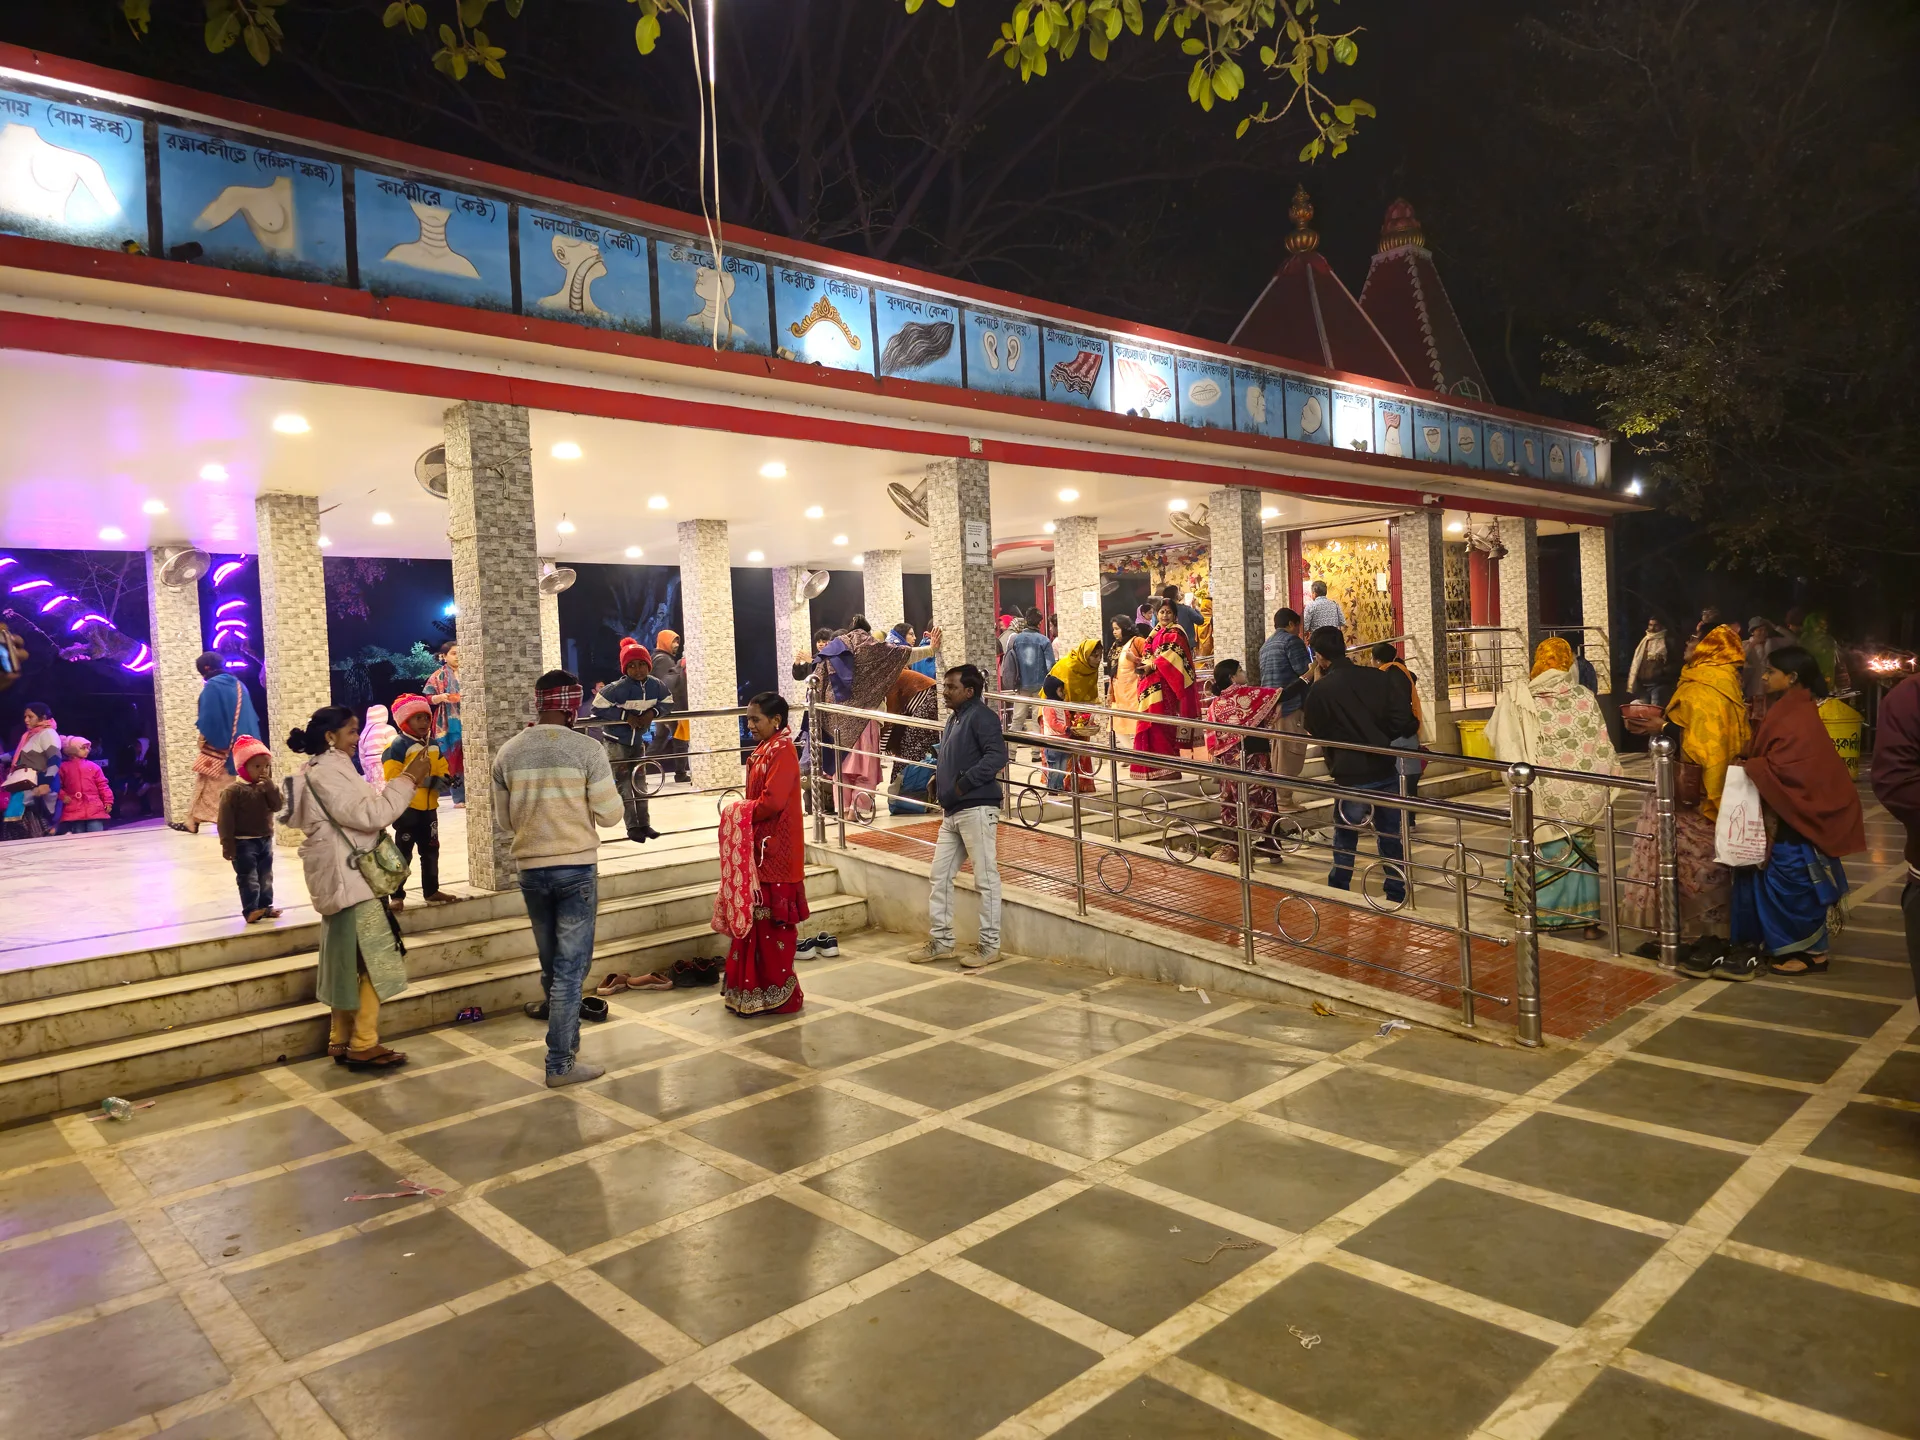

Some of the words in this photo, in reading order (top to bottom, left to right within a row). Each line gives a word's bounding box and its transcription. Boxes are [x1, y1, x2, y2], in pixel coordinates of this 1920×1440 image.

[47, 104, 86, 128] (বাম
[89, 116, 132, 143] স্কন্ধ)
[164, 133, 246, 163] রত্নাবলীতে
[254, 149, 297, 173] (দক্ষিণ
[300, 162, 334, 187] স্কন্ধ)
[530, 214, 600, 243] নলহাটিতে
[603, 229, 641, 257] (নলী)
[722, 257, 760, 283] (গ্রীবা)
[780, 270, 815, 291] কিরীটে
[823, 279, 863, 304] (কিরীট)
[924, 303, 954, 322] (কেশ)
